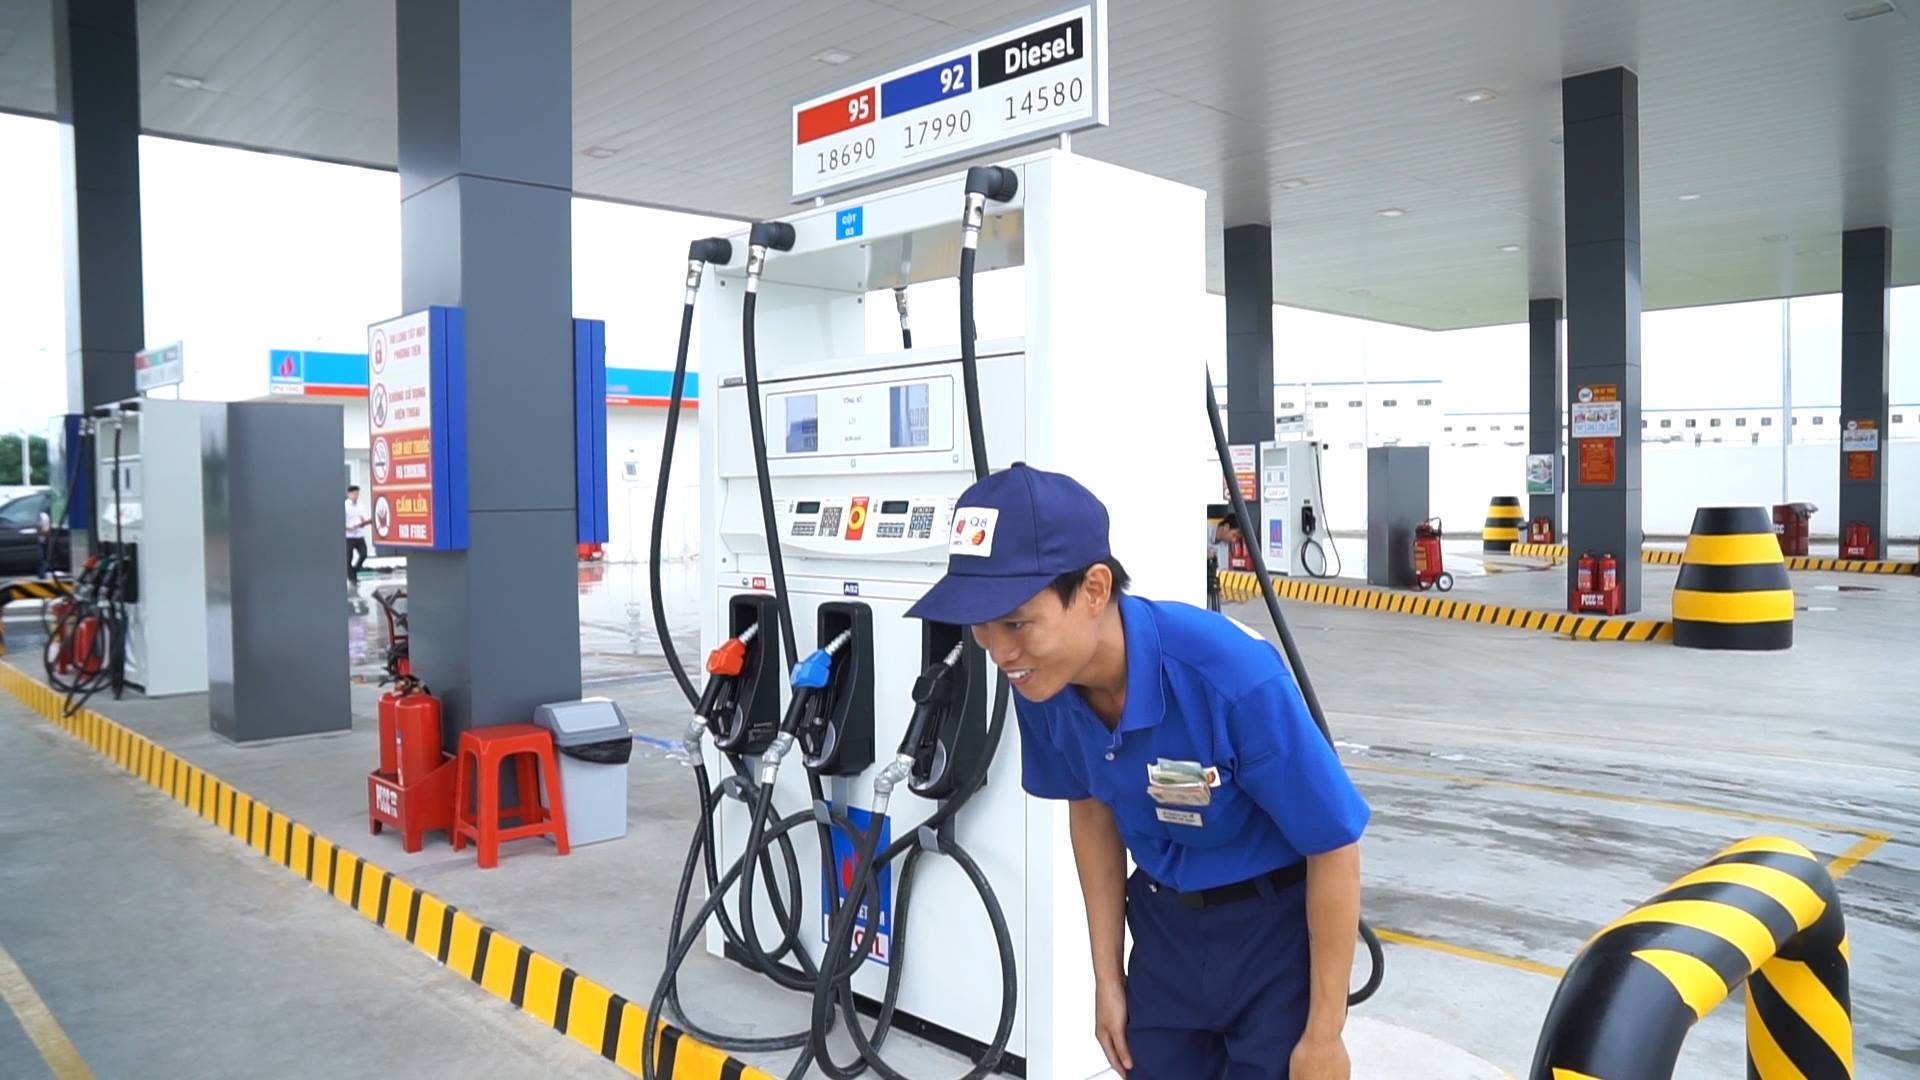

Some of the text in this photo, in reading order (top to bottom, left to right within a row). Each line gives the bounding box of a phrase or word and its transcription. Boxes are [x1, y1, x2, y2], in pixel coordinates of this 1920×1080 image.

[1004, 27, 1075, 75] Diesel
[939, 64, 965, 93] 92
[848, 95, 869, 122] 95
[1004, 77, 1083, 121] 14580
[903, 109, 972, 150] 17990
[816, 137, 876, 174] 18690
[970, 516, 987, 528] Q8
